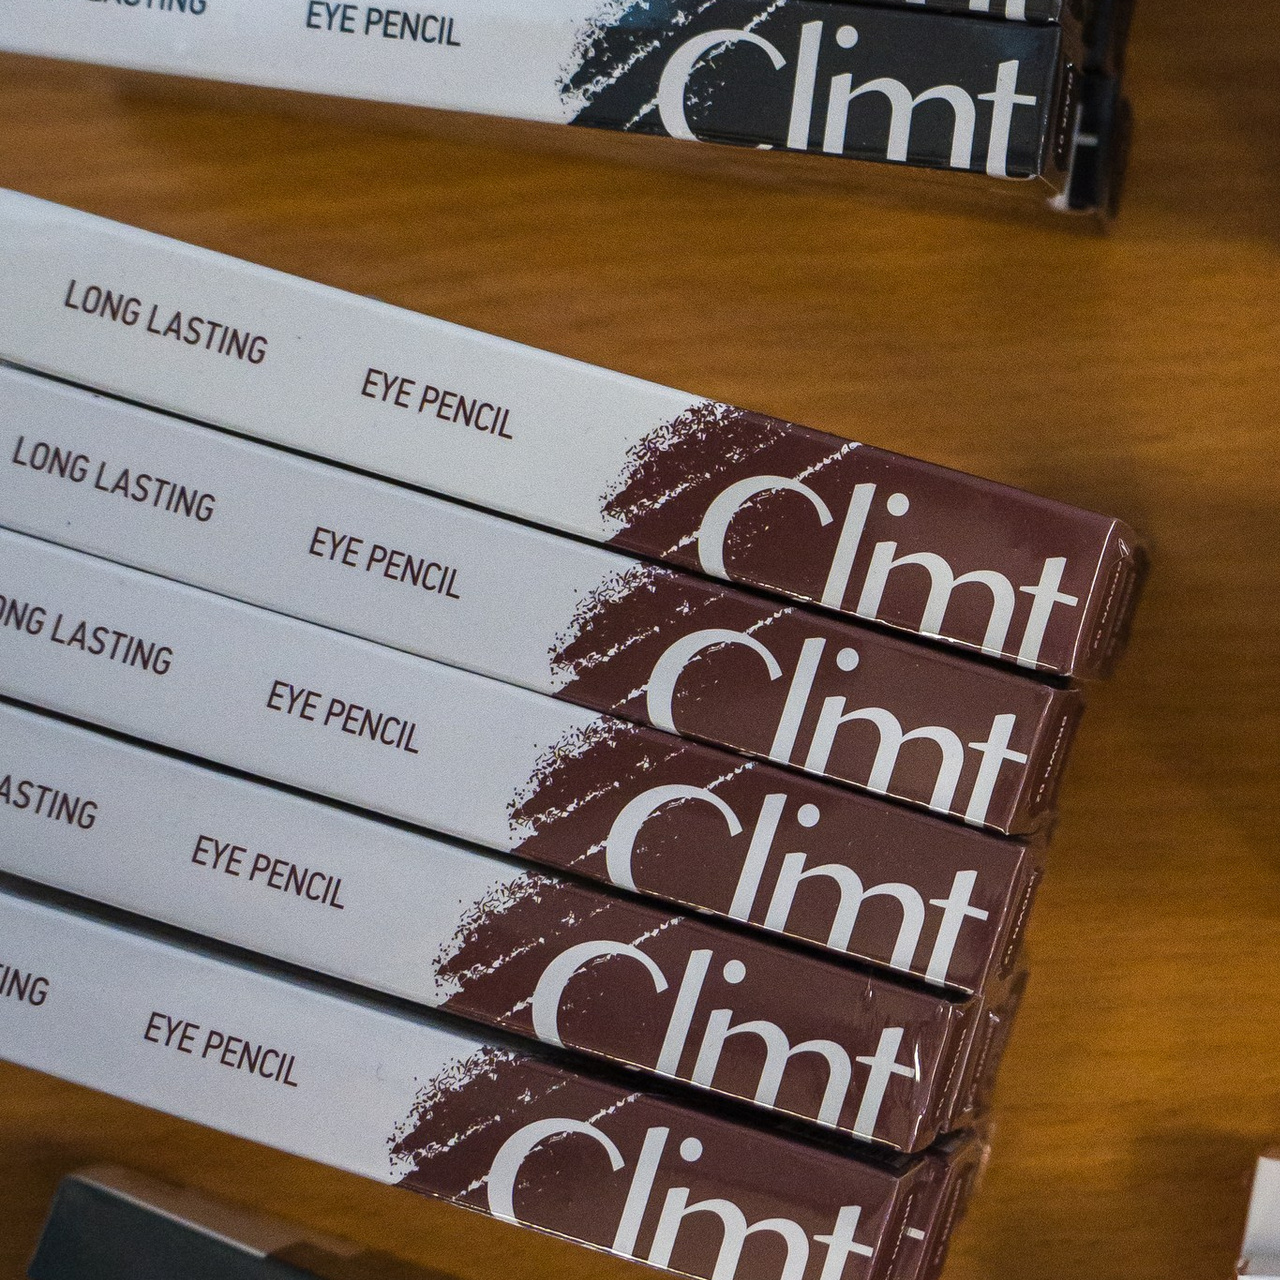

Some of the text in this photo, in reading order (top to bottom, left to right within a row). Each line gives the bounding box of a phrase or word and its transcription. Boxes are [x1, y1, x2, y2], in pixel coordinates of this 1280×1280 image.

[305, 0, 462, 48] EYE PENCIL
[658, 21, 1037, 180] Climt
[65, 279, 270, 365] LONG LASTING
[361, 367, 514, 440] EYE PENCIL
[12, 436, 217, 523] LONG LASTING
[308, 526, 461, 600] EYE PENCIL
[697, 475, 1079, 670] Climt
[50, 613, 174, 675] LASTING
[265, 680, 420, 755] EYE PENCIL
[646, 628, 1028, 828] Climt
[191, 835, 345, 910] EYE PENCIL
[605, 783, 989, 987] Climt
[143, 1011, 299, 1088] EYE PENCIL
[531, 940, 914, 1144] Climt
